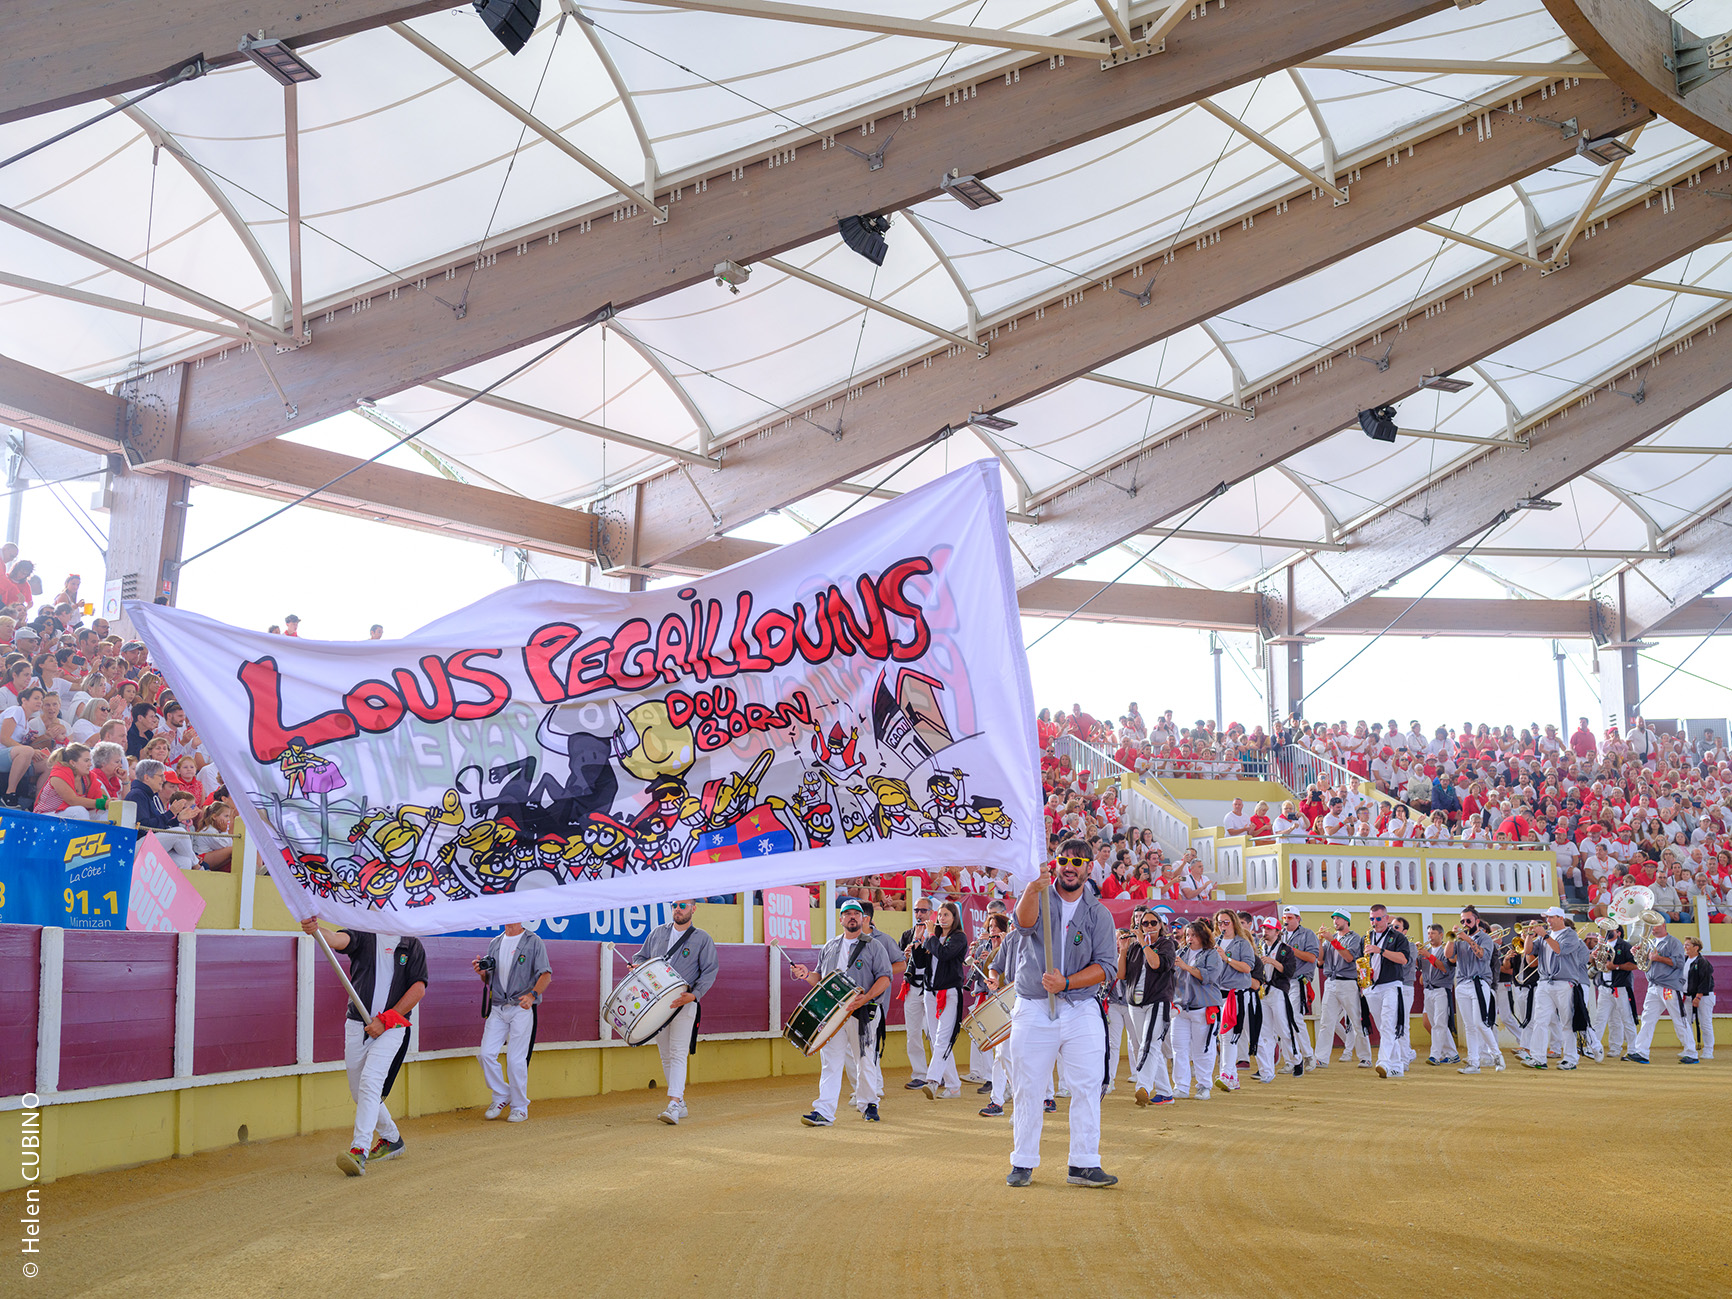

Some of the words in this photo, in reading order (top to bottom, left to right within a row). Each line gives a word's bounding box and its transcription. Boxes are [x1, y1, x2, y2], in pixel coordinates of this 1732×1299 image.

[237, 649, 512, 764] LOUS
[666, 685, 737, 729] DOU
[695, 691, 813, 752] BORN
[63, 832, 112, 864] FGL
[69, 873, 80, 884] La
[140, 851, 177, 910] SUD
[63, 887, 119, 915] 91.1
[128, 879, 179, 932] OUES
[768, 892, 793, 917] SUD
[70, 916, 112, 928] Mimizan
[768, 915, 806, 941] OUEST
